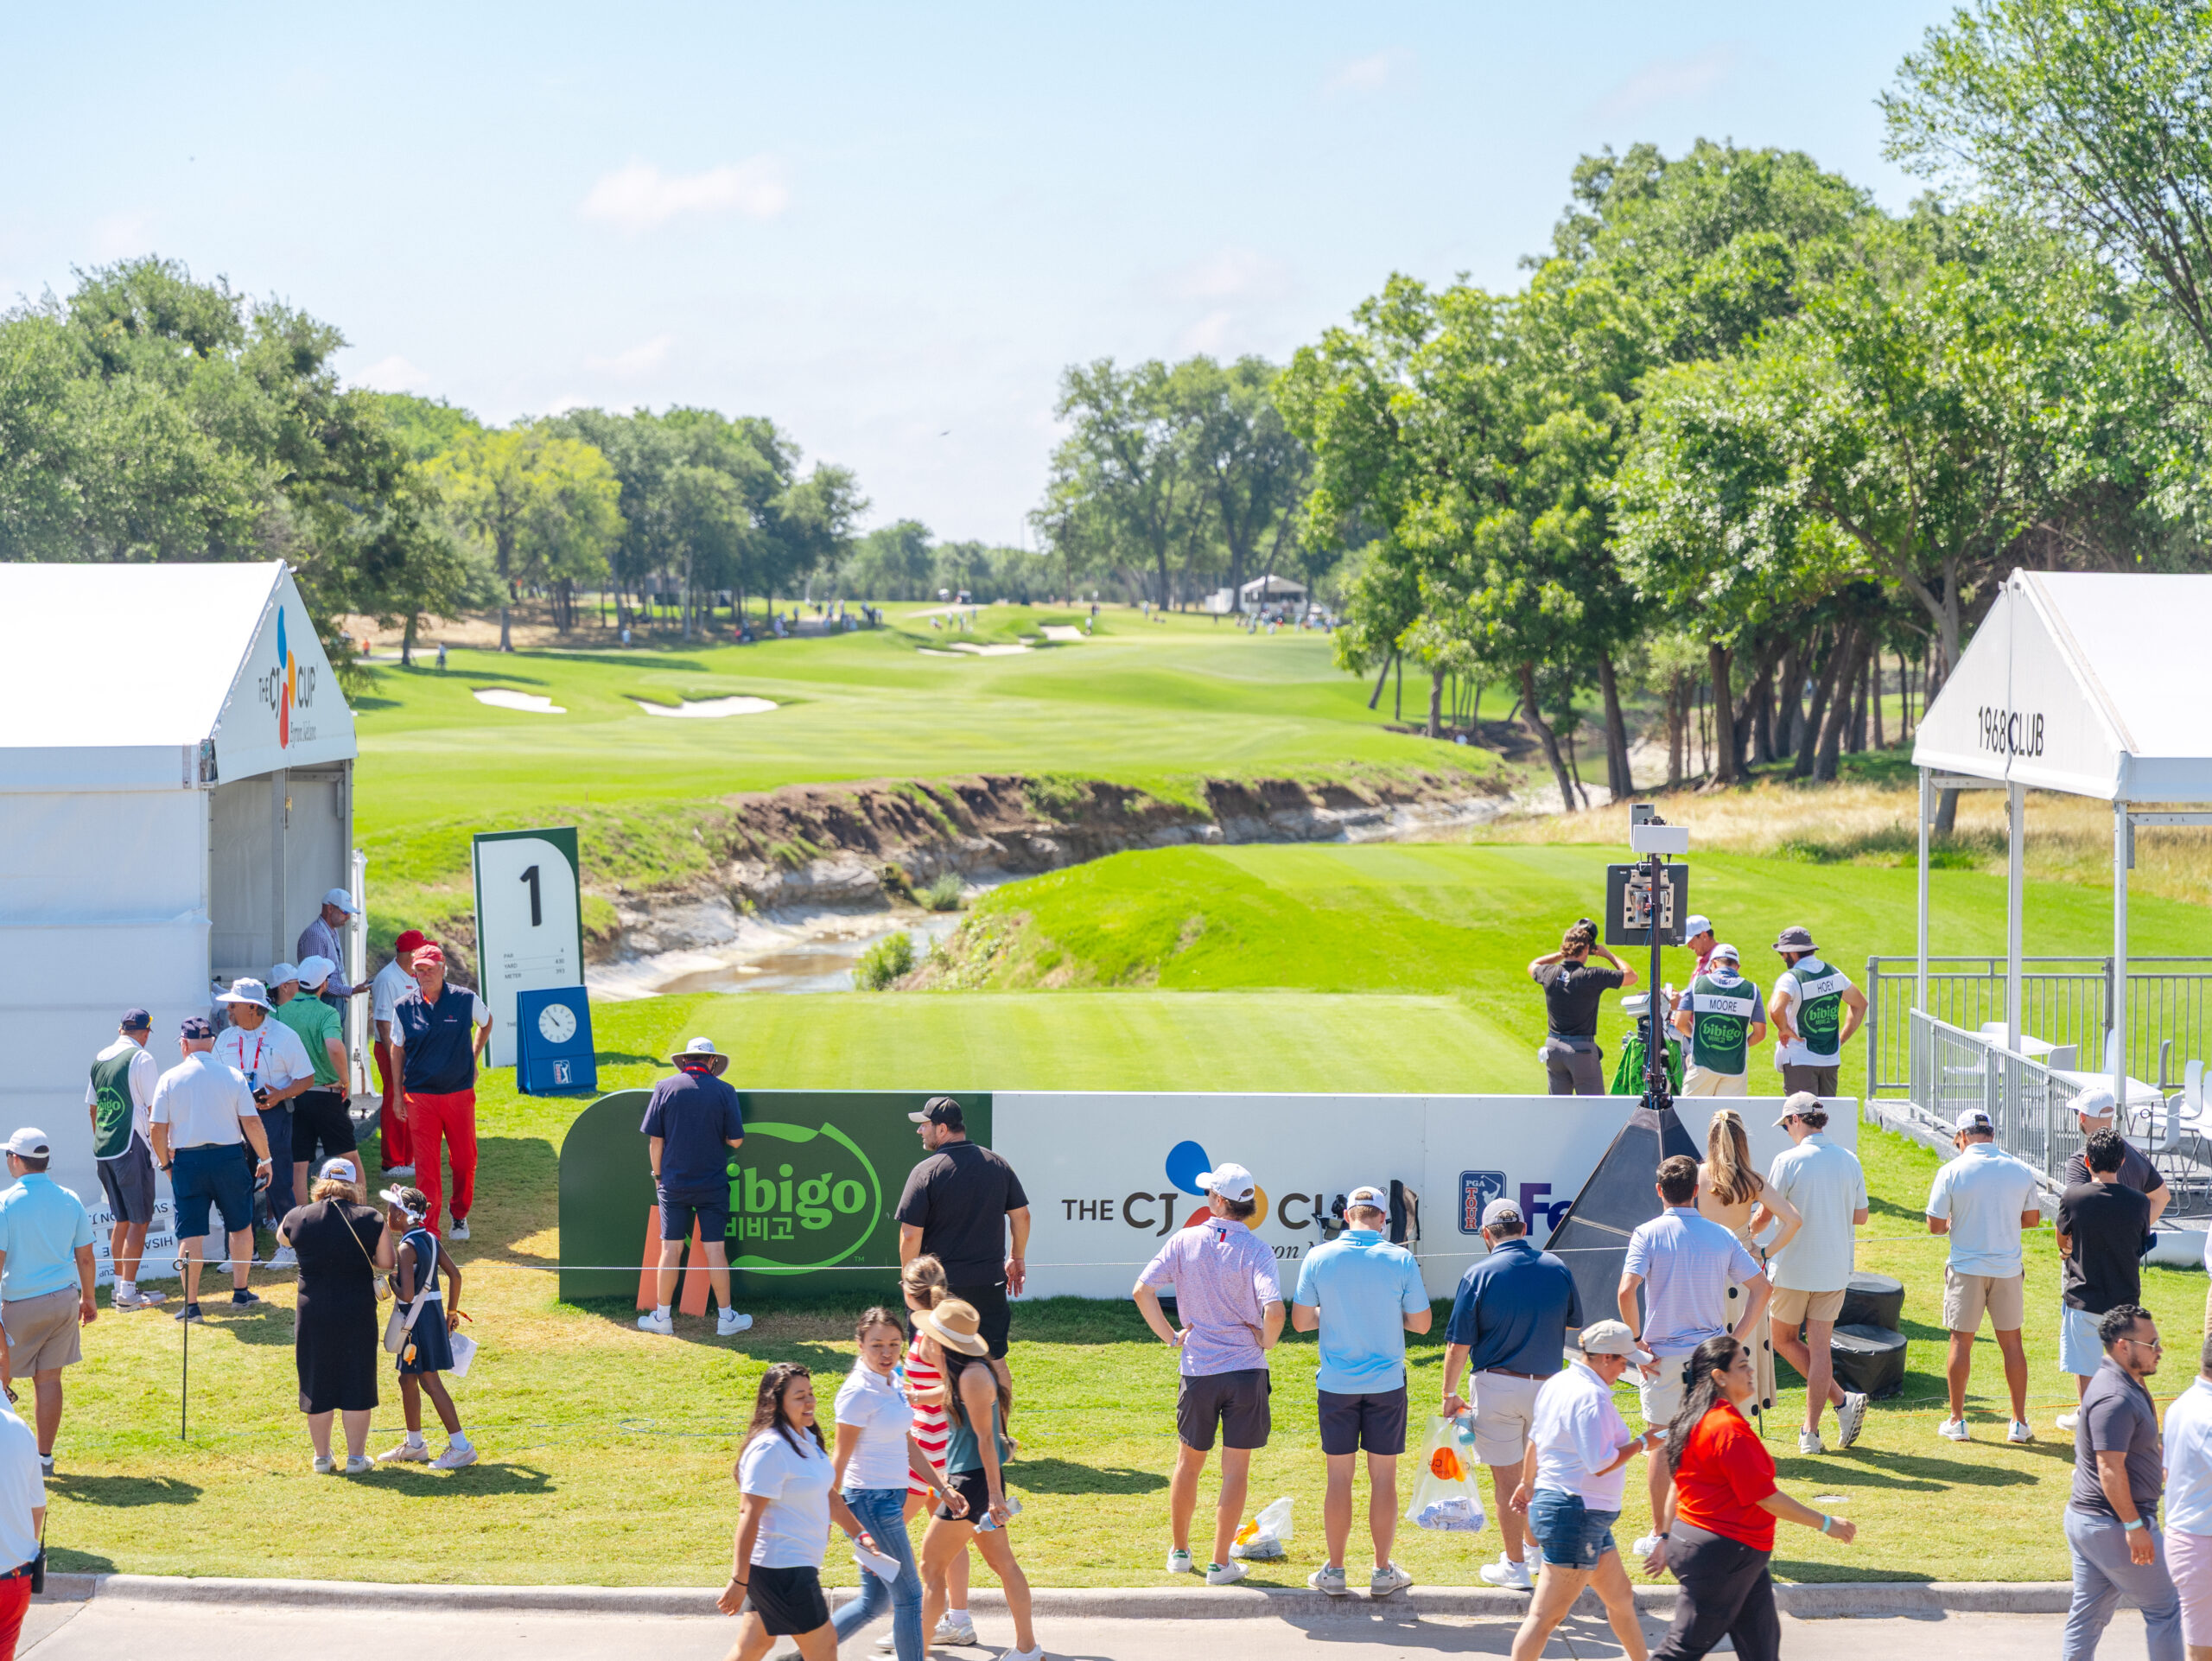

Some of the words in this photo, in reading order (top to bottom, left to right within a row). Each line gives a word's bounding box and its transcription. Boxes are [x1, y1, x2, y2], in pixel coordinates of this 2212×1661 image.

[258, 678, 269, 703] THE
[270, 666, 280, 719] CJ
[297, 665, 316, 709] CUP
[1979, 705, 2006, 754] 1968
[2008, 712, 2044, 758] CLUB
[519, 865, 542, 926] 1
[1709, 999, 1738, 1012] MOORE
[1817, 980, 1834, 994] HOEY
[1703, 1023, 1741, 1041] bibigo
[1809, 1005, 1838, 1021] bibig
[727, 1163, 867, 1230] ibigo
[1061, 1200, 1114, 1220] THE
[1123, 1192, 1178, 1237] CJ
[1465, 1187, 1478, 1229] TOUR
